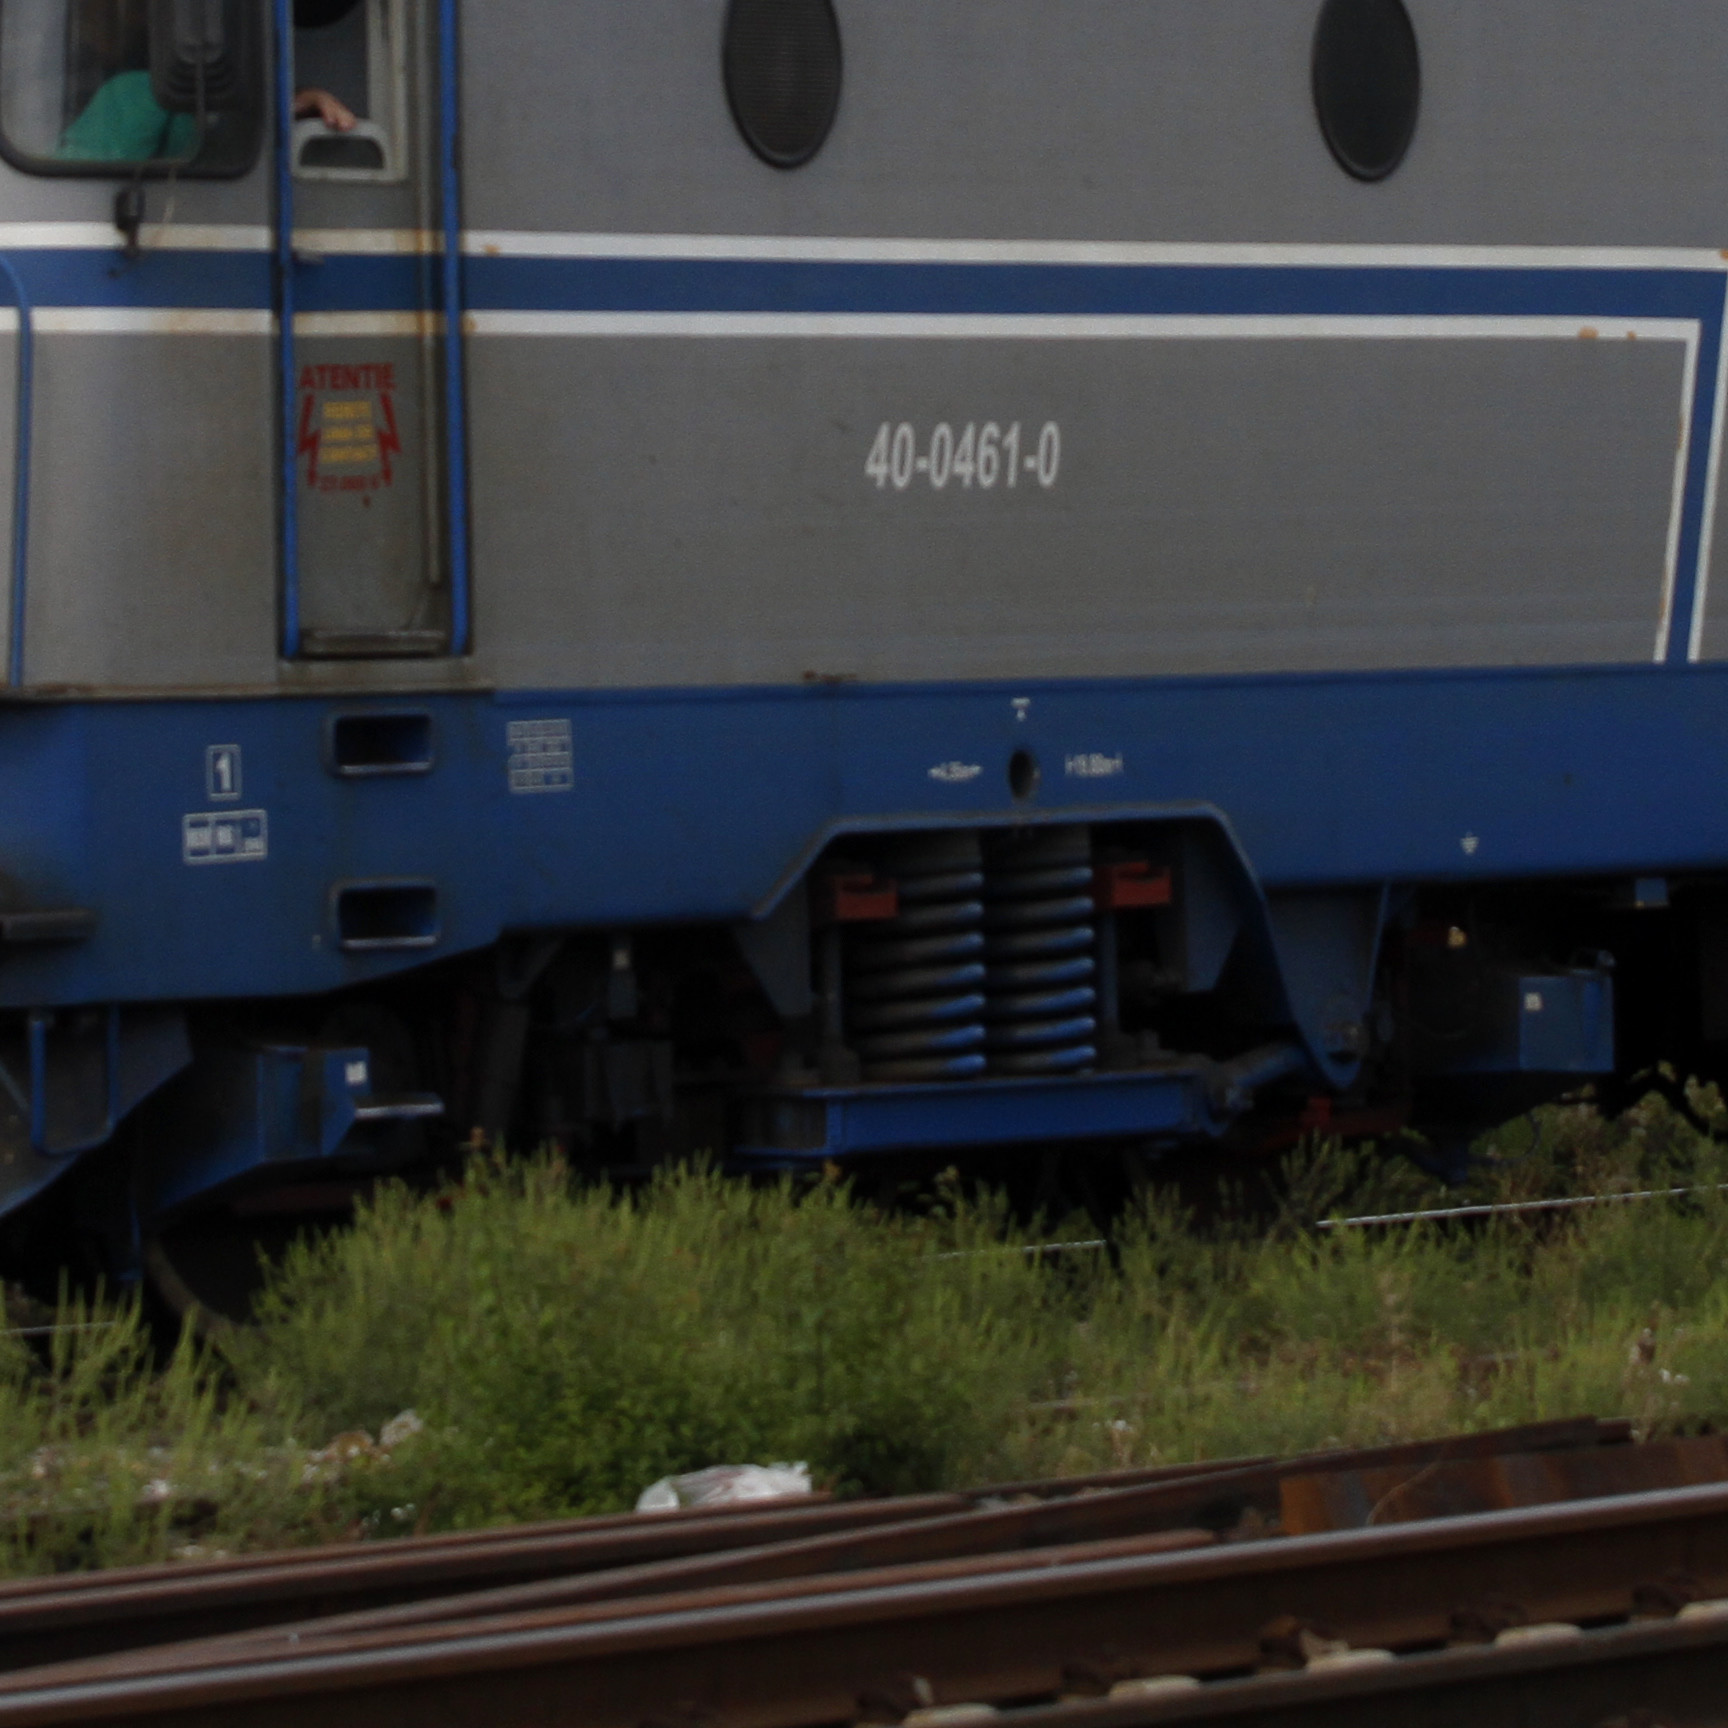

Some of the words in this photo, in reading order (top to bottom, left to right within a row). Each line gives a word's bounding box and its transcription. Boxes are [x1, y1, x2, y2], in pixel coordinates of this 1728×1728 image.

[299, 361, 397, 390] ATENTIE
[864, 420, 1062, 491] 40-0461-0
[215, 752, 233, 792] 1
